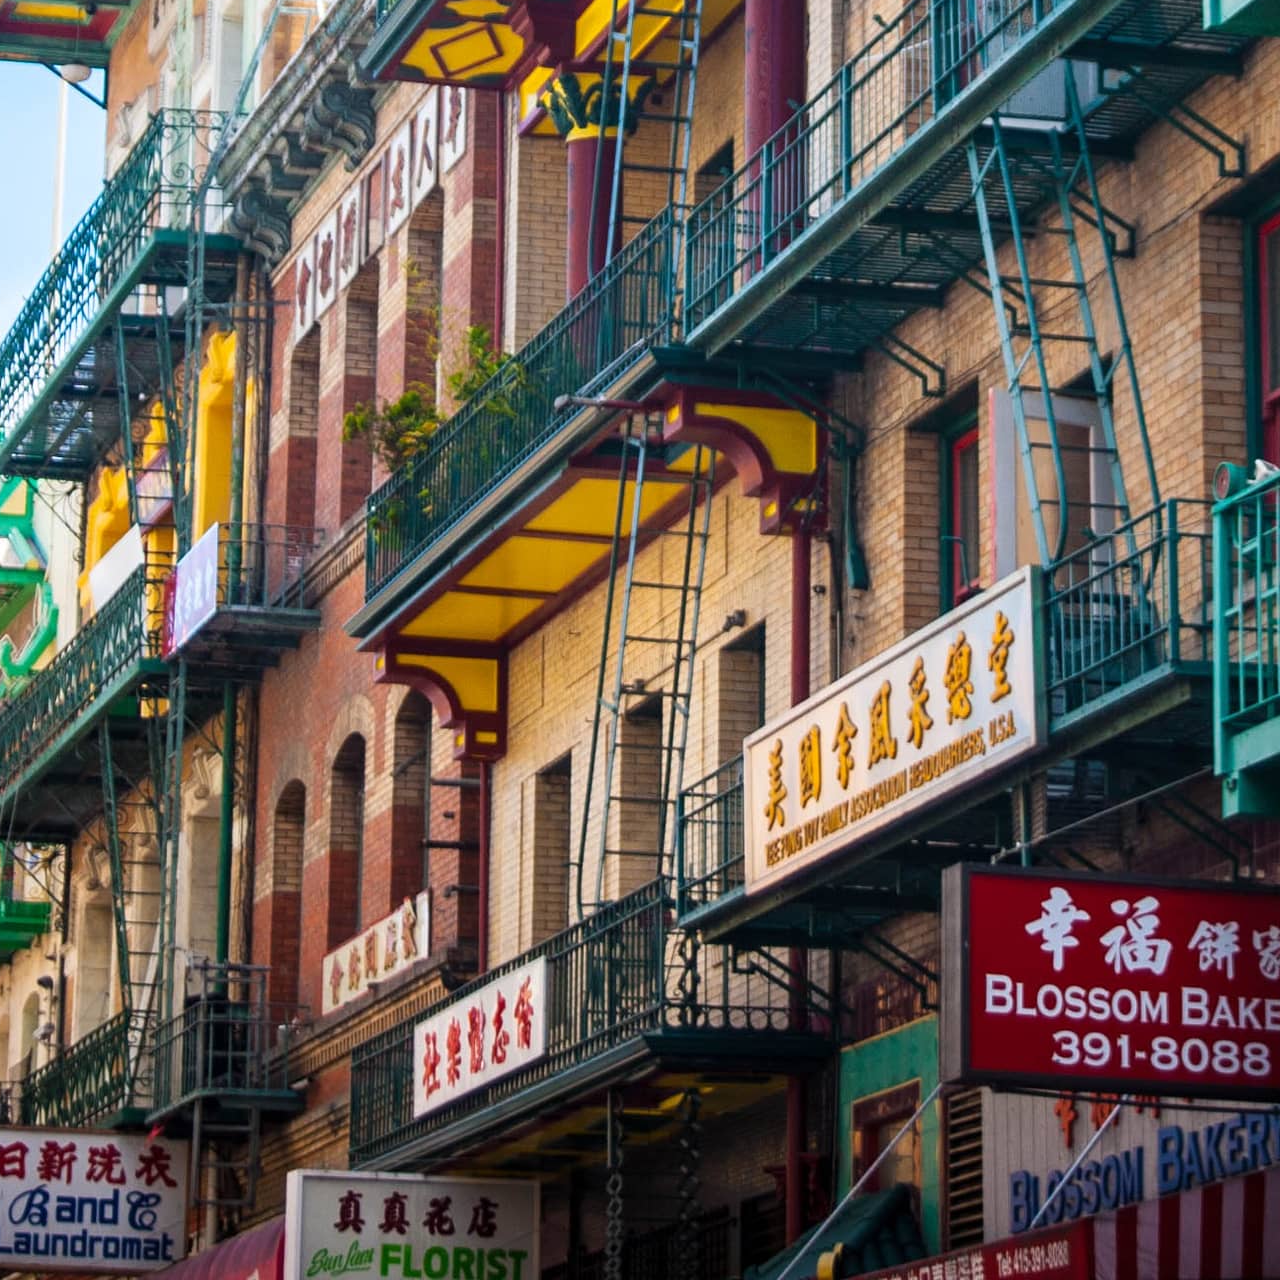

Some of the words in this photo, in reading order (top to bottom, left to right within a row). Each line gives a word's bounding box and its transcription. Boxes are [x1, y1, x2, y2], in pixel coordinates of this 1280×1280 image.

[985, 973, 1169, 1024] BLOSSOM
[1052, 1030, 1271, 1076] 391-8088
[55, 1189, 119, 1225] and
[1010, 1146, 1144, 1235] BLOSSOM
[380, 1243, 529, 1280] FLORIST
